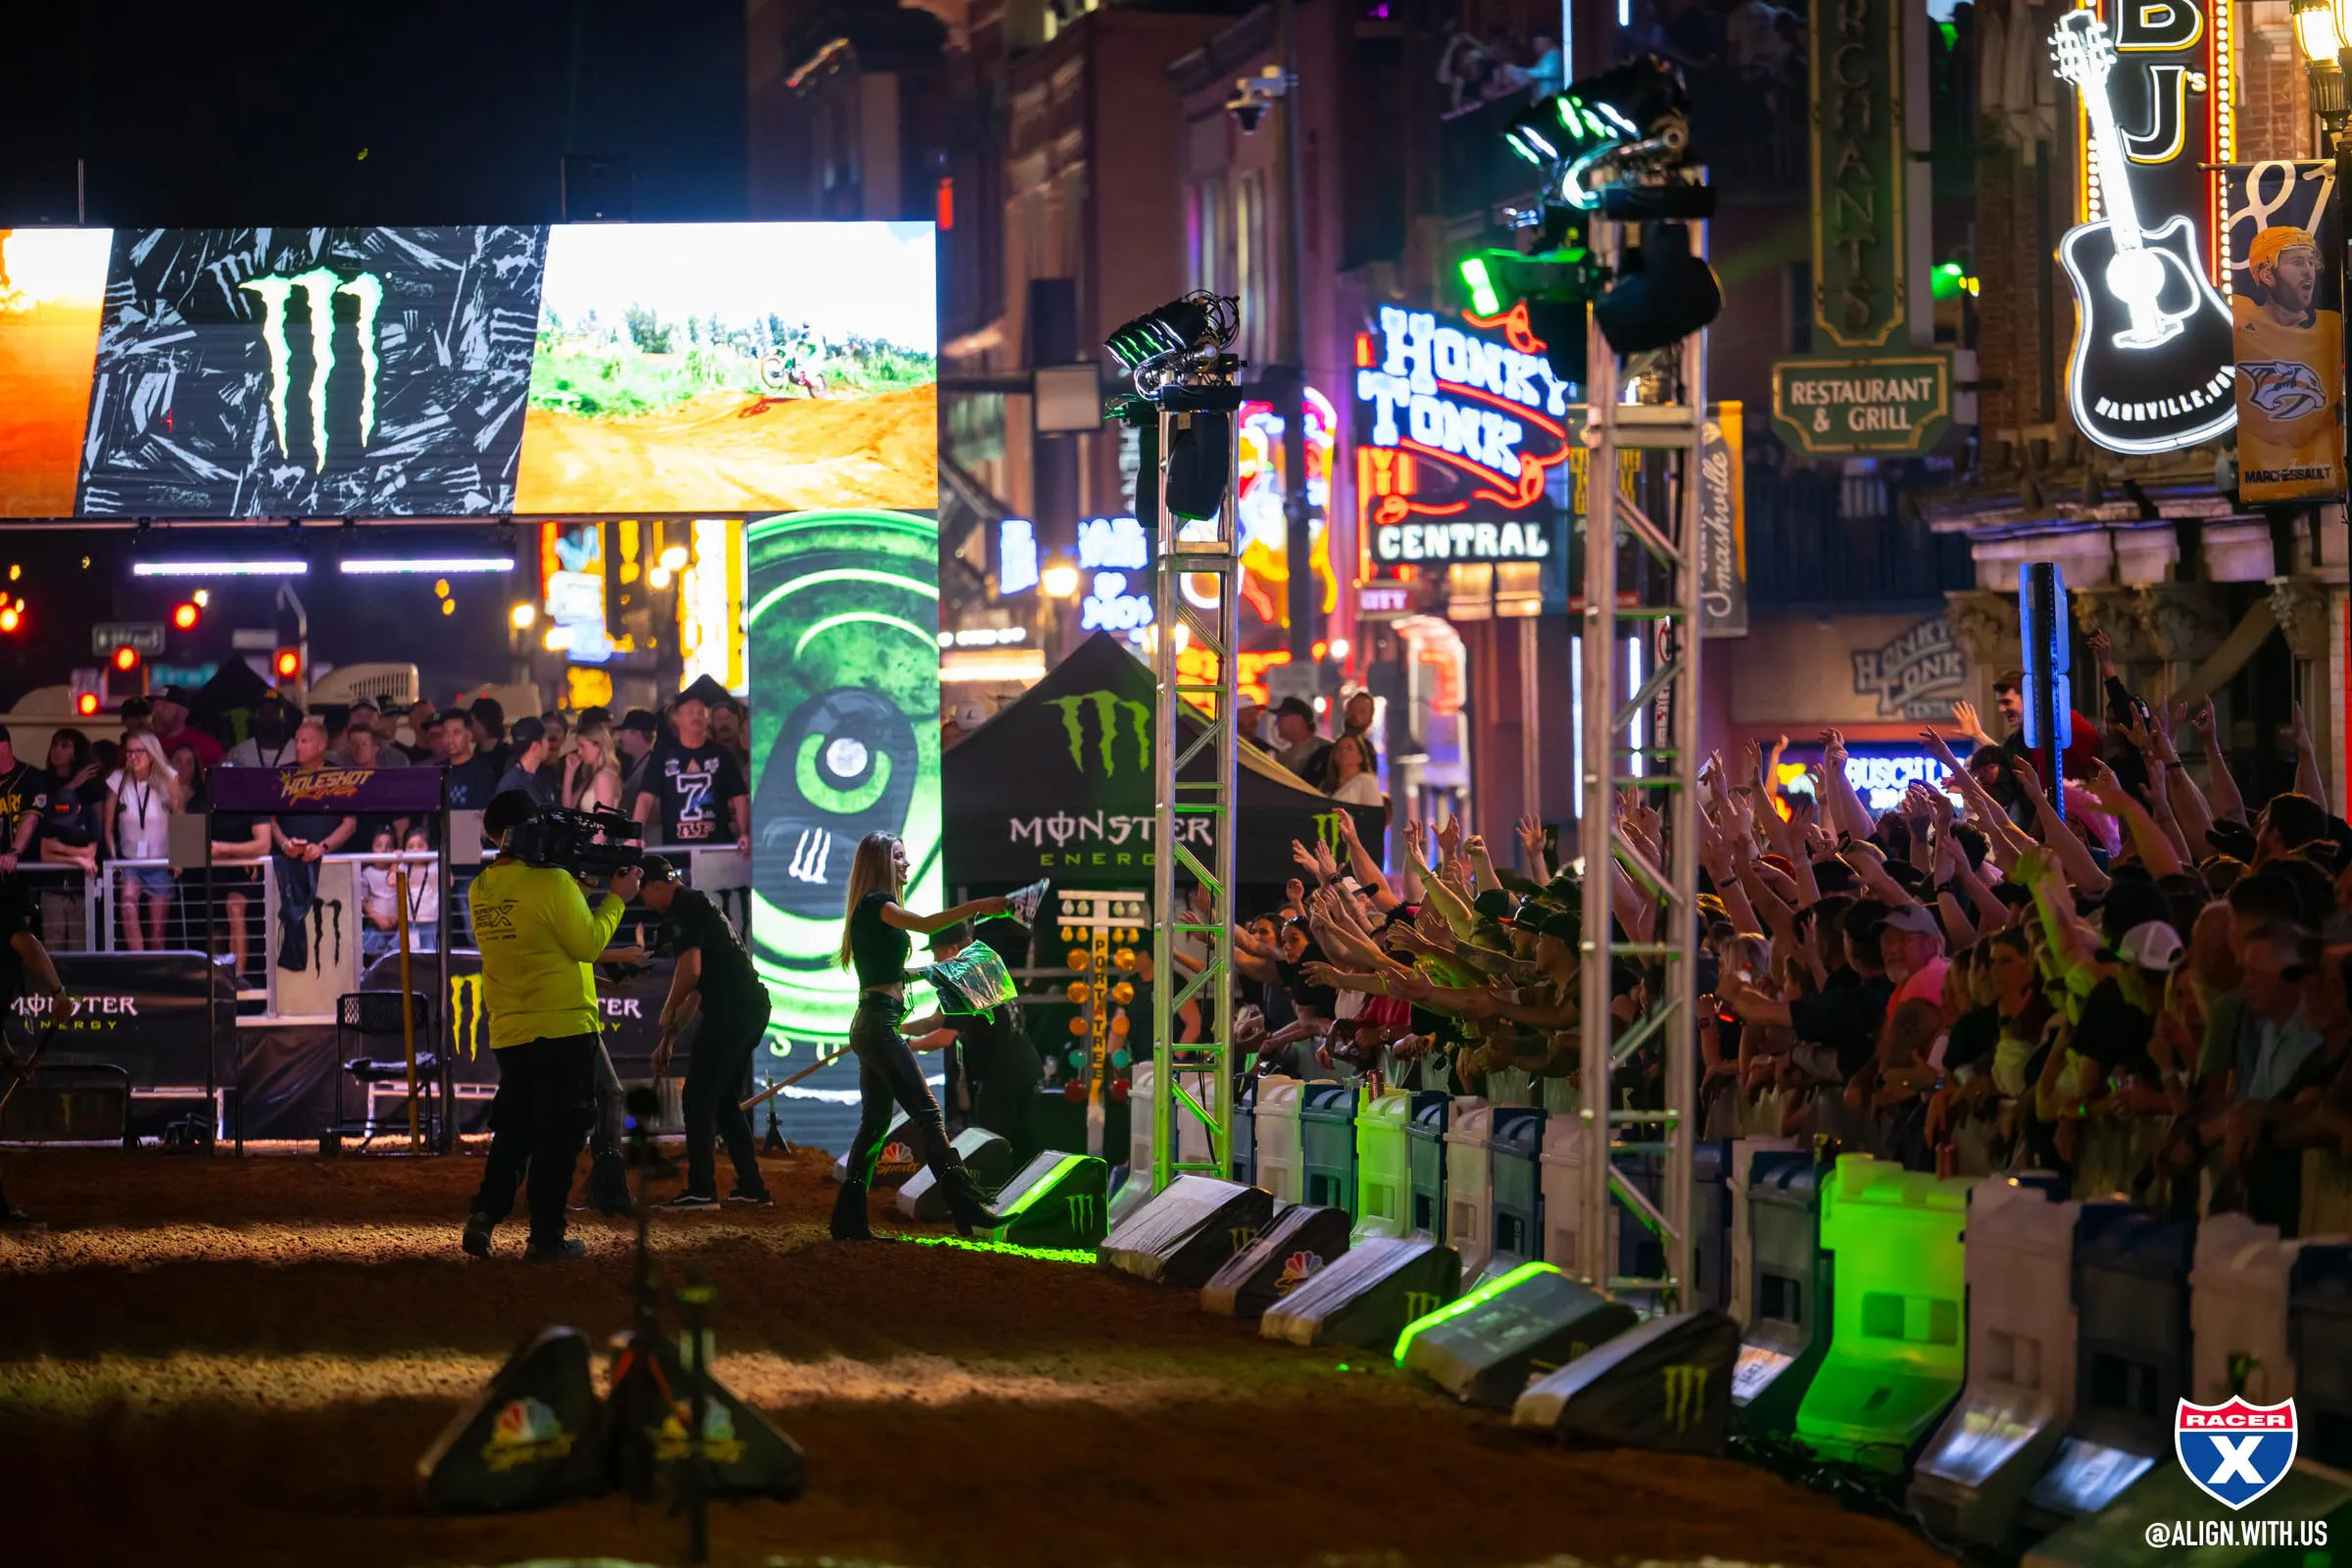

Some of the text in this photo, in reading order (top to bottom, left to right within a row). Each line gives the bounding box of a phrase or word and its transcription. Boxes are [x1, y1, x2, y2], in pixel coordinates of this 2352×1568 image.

[1379, 305, 1570, 416] HONKY
[1790, 376, 1934, 405] RESTAURANT
[1357, 369, 1522, 478] TONK
[1813, 406, 1912, 432] & GRILL
[1378, 521, 1549, 560] CENTRAL
[281, 769, 374, 799] HOLESHOT
[1844, 757, 1924, 791] BUSCH
[676, 773, 711, 821] 7
[1040, 853, 1180, 866] ENERG
[1093, 939, 1105, 1079] PORTATREE
